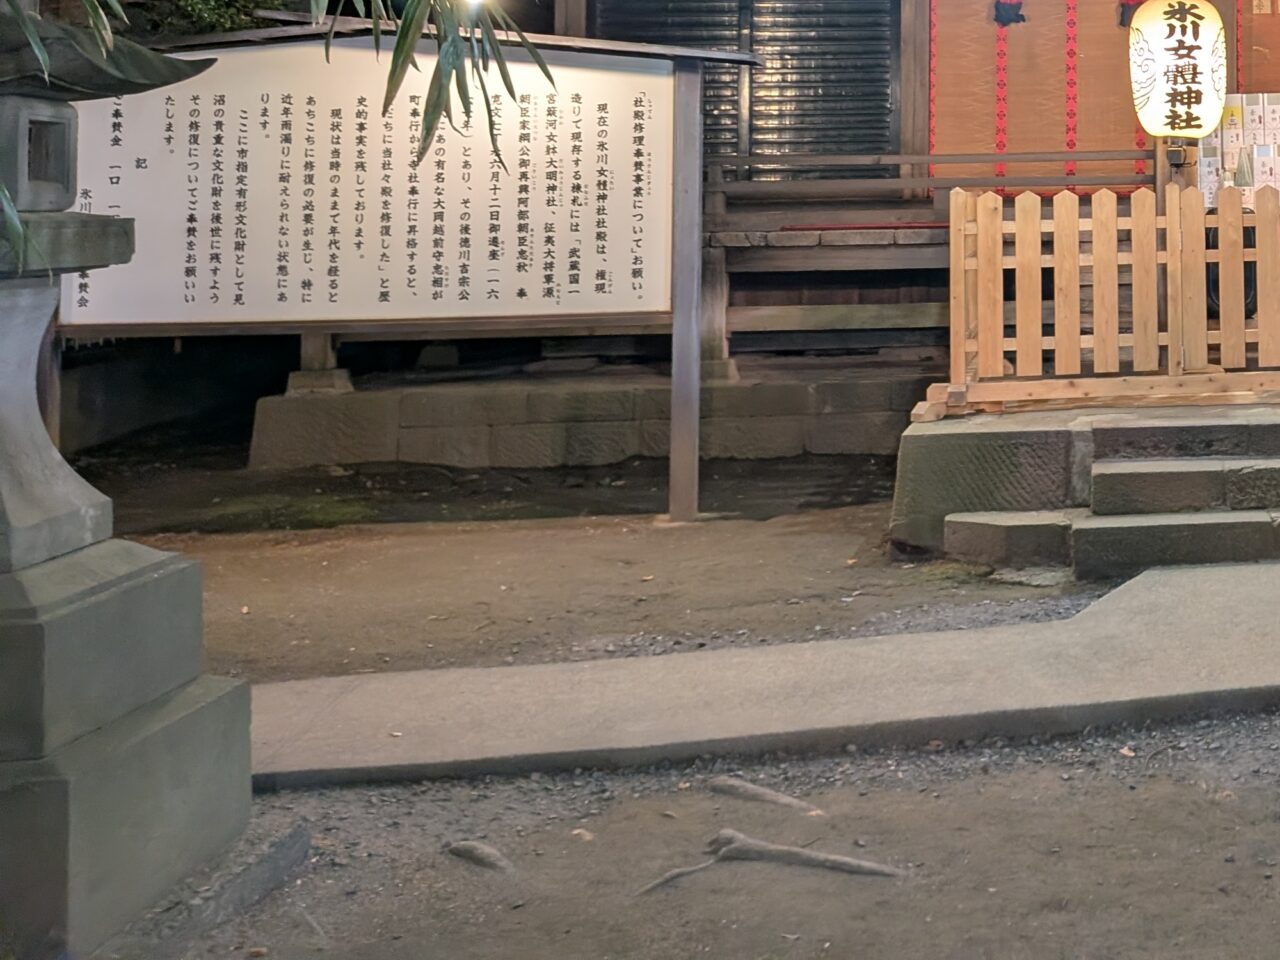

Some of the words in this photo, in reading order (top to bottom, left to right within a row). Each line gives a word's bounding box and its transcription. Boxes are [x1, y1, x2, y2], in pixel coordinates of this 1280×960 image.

[1162, 0, 1205, 131] 氷川女體神社
[163, 95, 176, 154] たします。
[259, 92, 270, 139] ります。
[134, 157, 148, 170] 記
[209, 94, 226, 304] 沼の貴重な文化財を後世に残すよう
[233, 109, 249, 306] ここに市指定有形文化財として見
